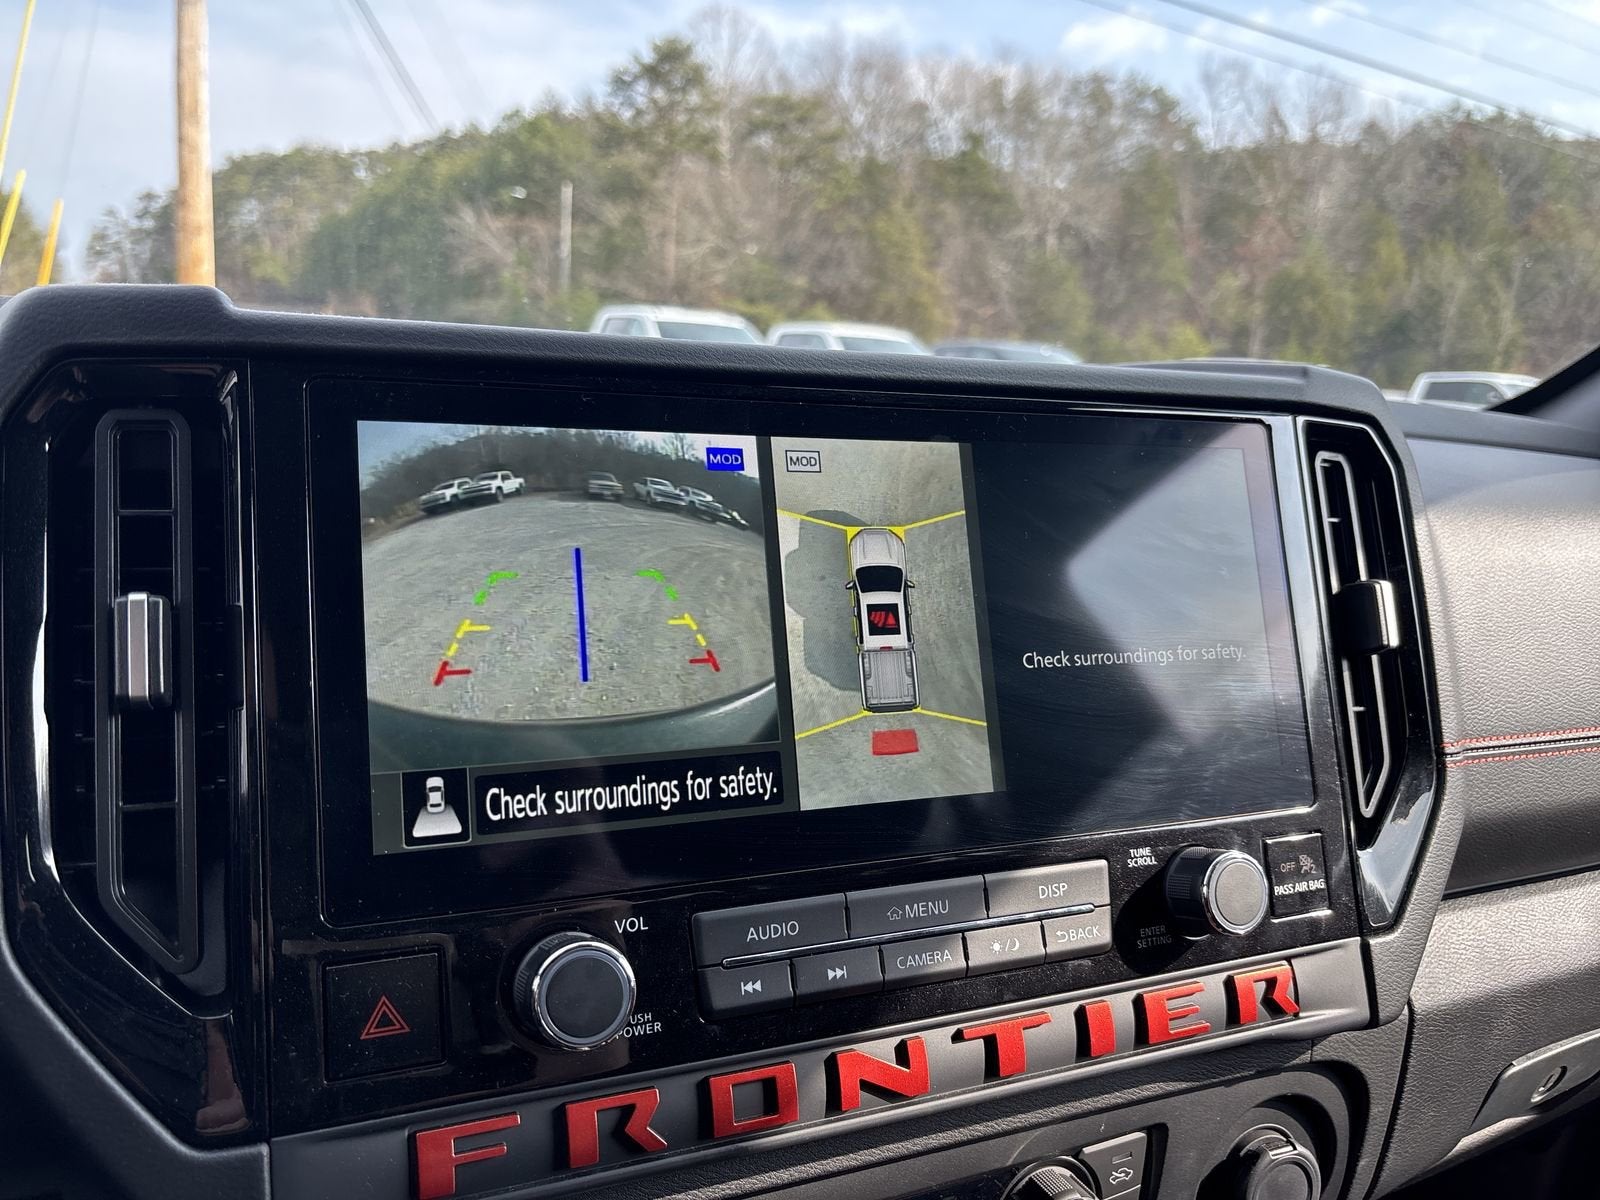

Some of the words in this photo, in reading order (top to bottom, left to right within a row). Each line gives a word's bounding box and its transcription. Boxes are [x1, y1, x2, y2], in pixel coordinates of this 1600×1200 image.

[709, 453, 742, 465] MOD
[789, 456, 818, 467] MOD
[1022, 650, 1071, 669] Check
[1073, 647, 1174, 666] surroundings
[1176, 645, 1198, 662] for
[1200, 643, 1247, 663] safety.
[485, 784, 548, 822] Check
[554, 775, 680, 815] surroundings
[686, 770, 713, 801] for
[719, 765, 778, 801] safety.
[1129, 846, 1152, 858] TUNE
[1127, 855, 1158, 868] SCROLL
[1280, 861, 1296, 873] OFF
[1038, 882, 1068, 900] DISP
[1273, 884, 1294, 896] PASS
[1294, 881, 1309, 893] AIR
[1308, 878, 1326, 891] BAG
[905, 899, 949, 918] MENU
[614, 916, 649, 934] VOL
[746, 920, 799, 943] AUDIO
[1068, 924, 1101, 941] BACK
[1139, 924, 1166, 938] ENTER
[1136, 934, 1173, 950] SETTING
[896, 949, 953, 970] CAMERA
[630, 1012, 652, 1025] USH
[415, 963, 1299, 1199] FRONTIER
